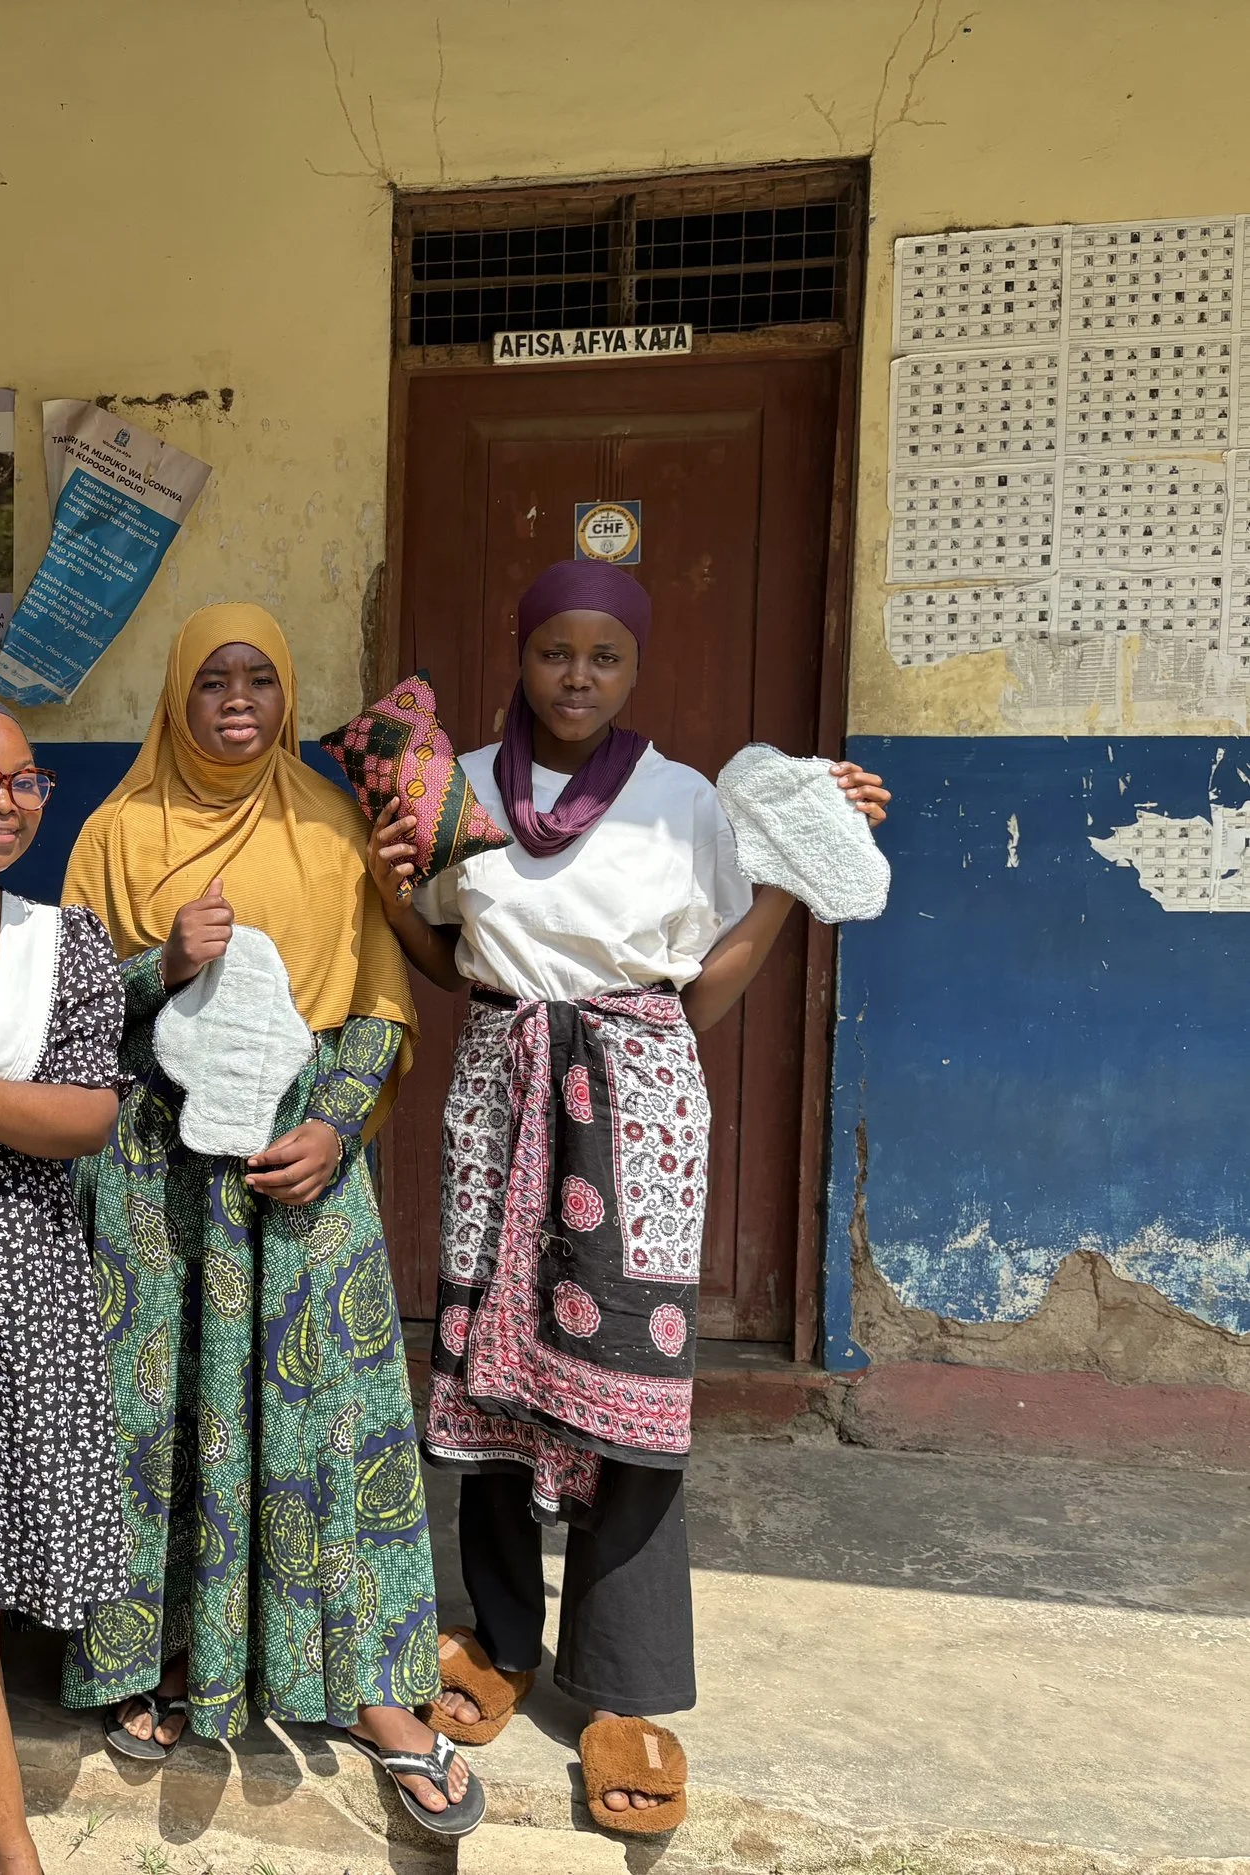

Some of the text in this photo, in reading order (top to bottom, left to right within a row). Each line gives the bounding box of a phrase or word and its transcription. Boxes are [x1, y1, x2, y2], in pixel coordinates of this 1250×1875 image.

[500, 326, 687, 357] AFISA AFYA KATA
[64, 445, 145, 495] YA KUPOOZA (POLIO)
[79, 440, 89, 451] YA
[91, 448, 126, 471] MLIPUKO
[128, 468, 141, 480] WA
[143, 478, 181, 501] UGONJWA
[63, 502, 88, 519] maisha
[74, 484, 159, 536] husababisha ulemavu wa
[79, 475, 140, 514] Ugonjwa wa Polio
[69, 492, 98, 513] kudumu
[109, 516, 125, 528] hata
[125, 525, 157, 547] kupoteza
[592, 523, 623, 534] CHF
[50, 541, 112, 581] anjo ya matone ya
[57, 534, 92, 556] unazuilika
[93, 553, 107, 566] kwa
[109, 563, 133, 581] kupata
[66, 561, 84, 576] Polio
[83, 535, 97, 548] huu
[100, 546, 122, 563] hauna
[123, 560, 137, 572] tiba
[20, 605, 38, 618] Polio
[39, 583, 59, 596] chini
[58, 594, 67, 602] ya
[68, 600, 88, 615] miaka
[47, 598, 70, 615] chanjo
[70, 612, 81, 621] hii
[62, 584, 83, 599] mtoto
[84, 597, 102, 611] wako
[103, 609, 113, 618] wa
[48, 611, 66, 624] dhidi
[64, 622, 74, 630] ya
[75, 628, 102, 647] ugonjwa
[45, 644, 62, 658] Okoa
[62, 656, 85, 673] Maisha
[443, 1450, 479, 1459] KHANGA
